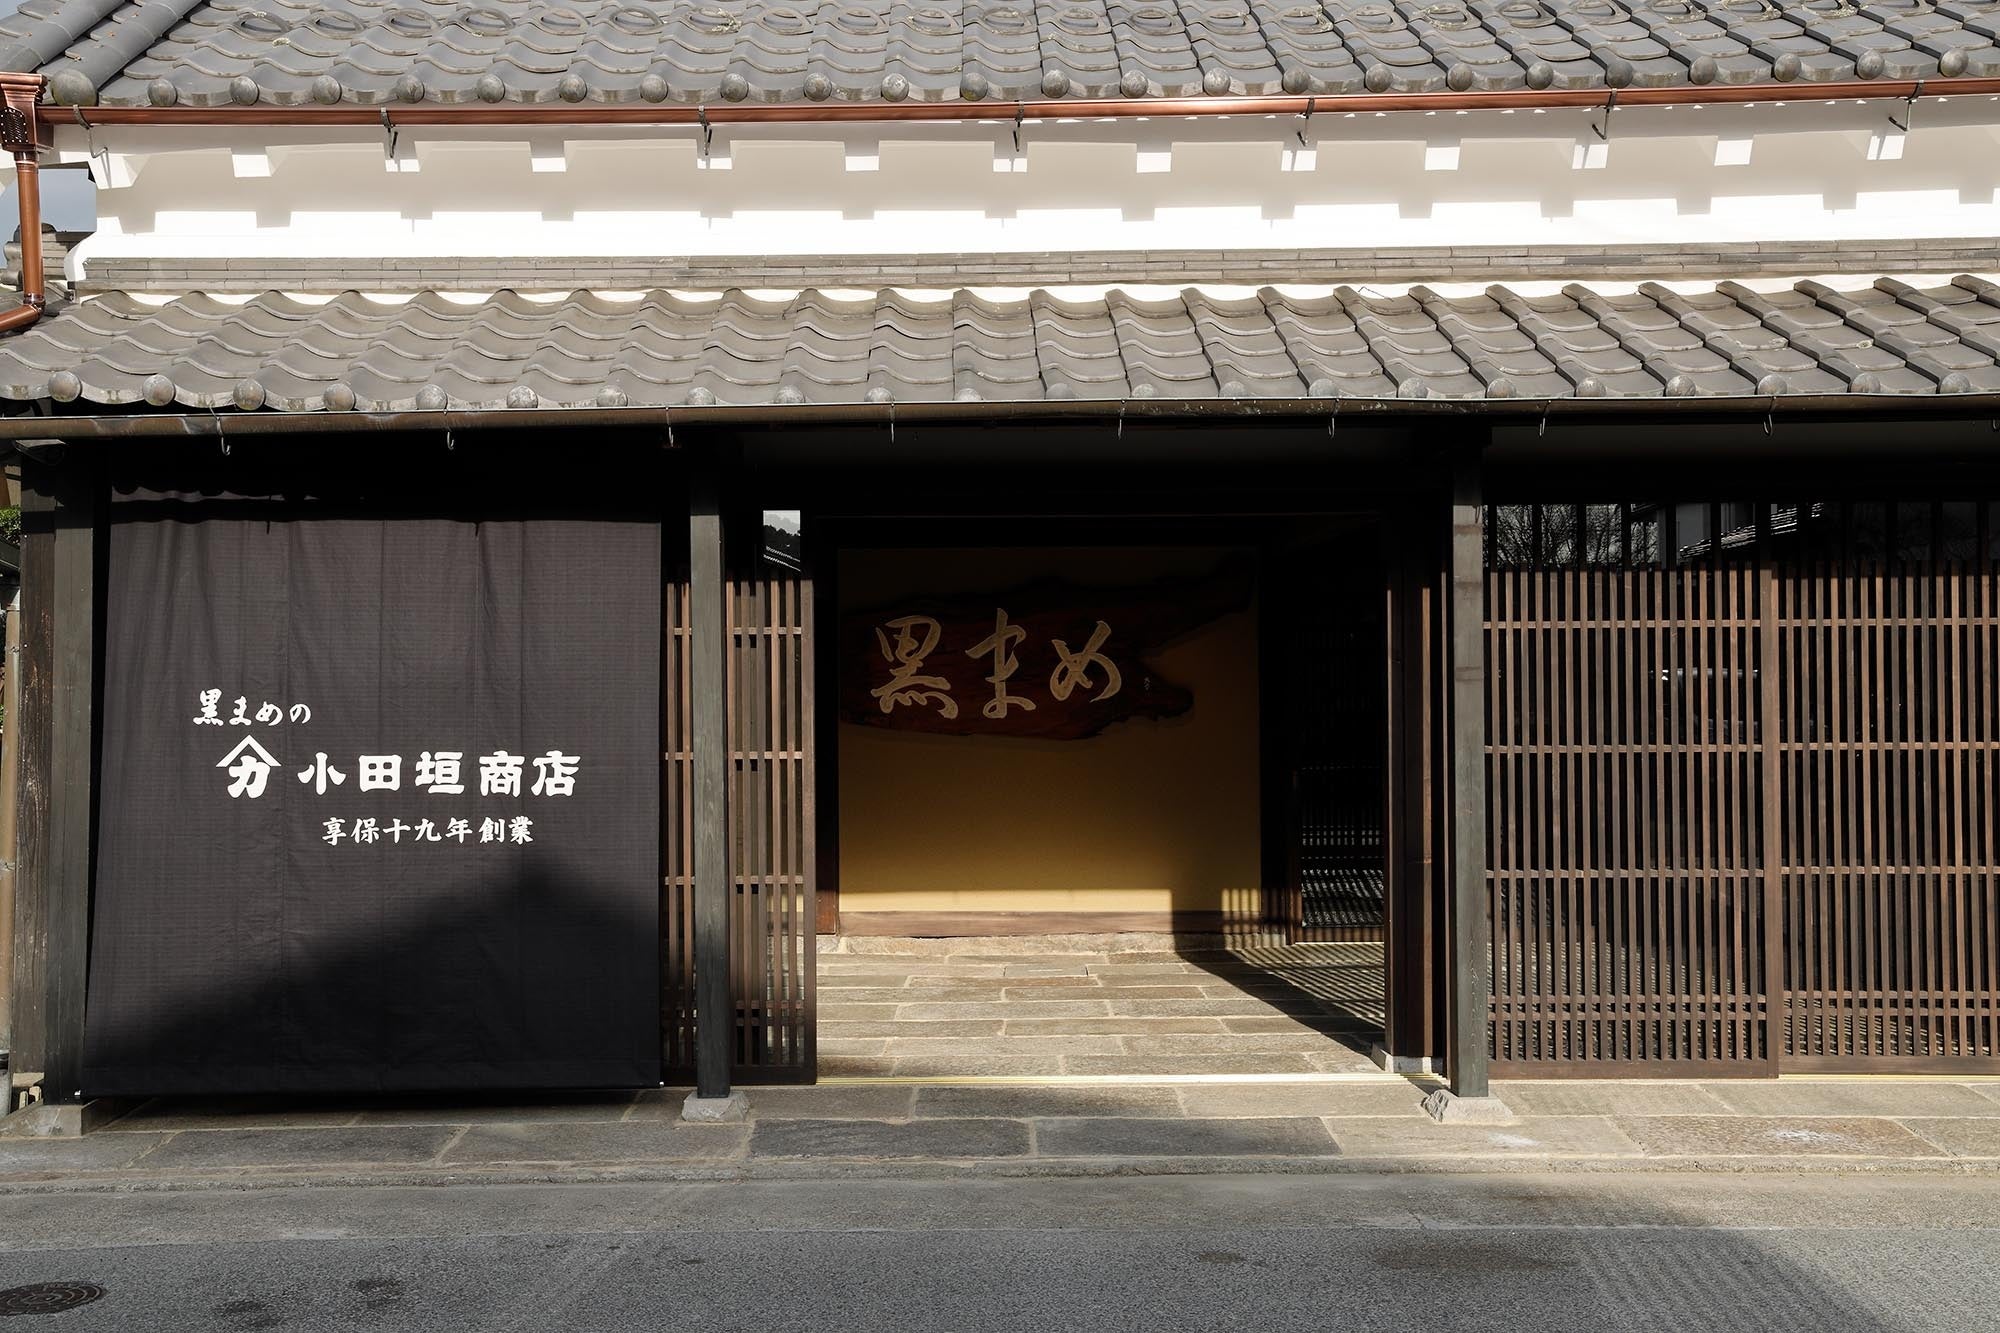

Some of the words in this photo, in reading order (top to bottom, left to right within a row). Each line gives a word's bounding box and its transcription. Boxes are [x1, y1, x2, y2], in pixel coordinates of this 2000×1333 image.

[871, 608, 1122, 719] 黒まめ
[193, 689, 311, 726] 黒まめの
[298, 750, 580, 797] 小田垣商店
[322, 816, 533, 845] 享保十九年創業
